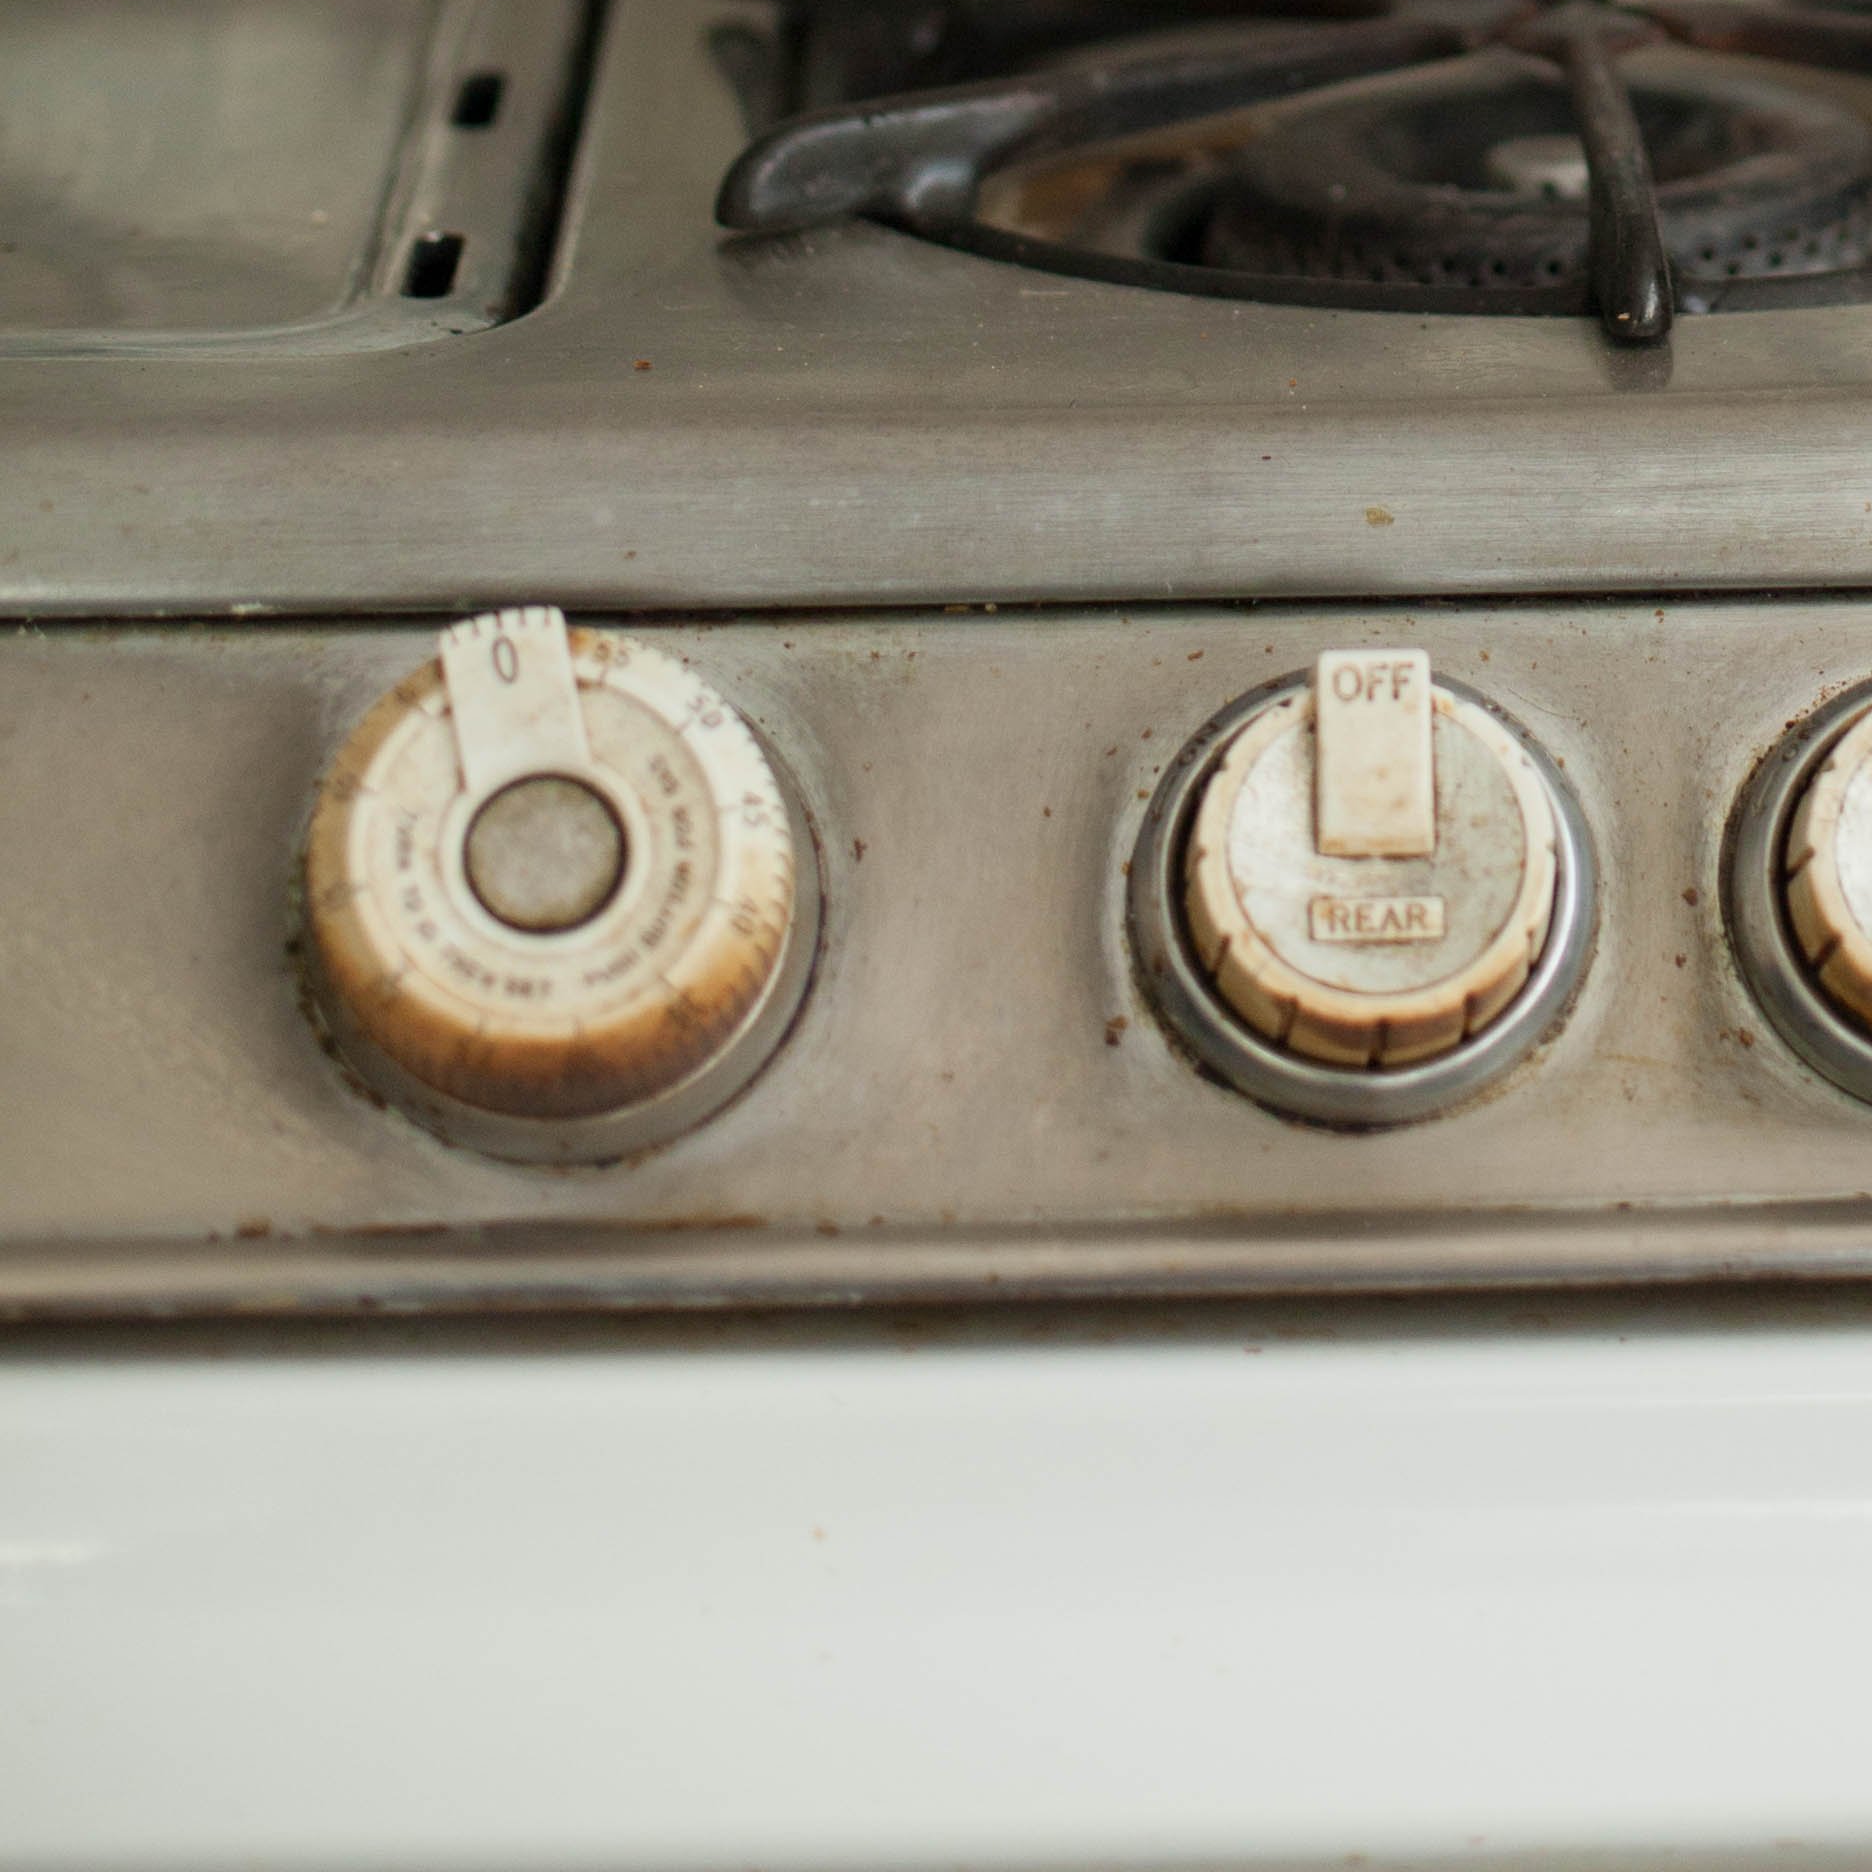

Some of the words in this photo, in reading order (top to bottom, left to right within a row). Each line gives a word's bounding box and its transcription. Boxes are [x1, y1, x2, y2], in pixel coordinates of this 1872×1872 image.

[492, 636, 520, 683] 0
[1331, 662, 1416, 702] OFF
[686, 694, 724, 729] 50
[742, 790, 771, 827] 45
[731, 897, 759, 936] 40
[1327, 903, 1430, 935] REAR
